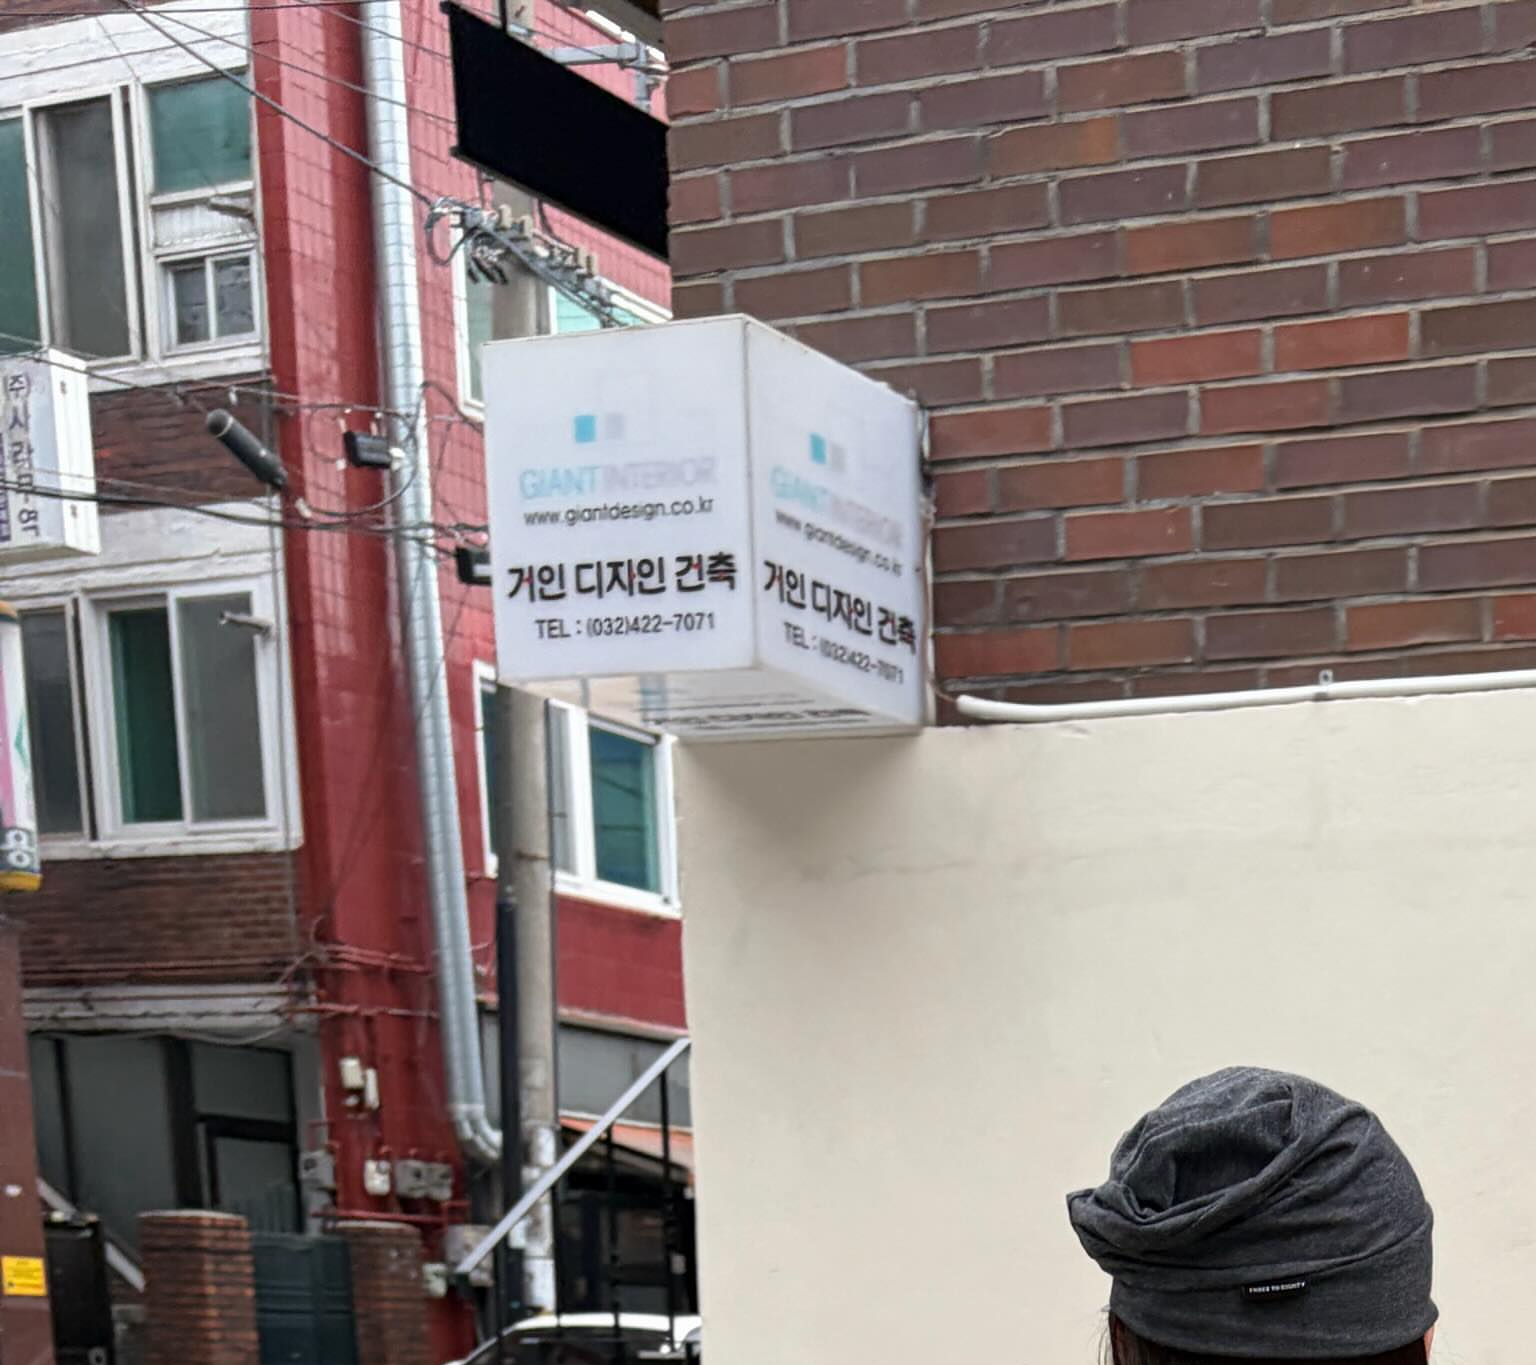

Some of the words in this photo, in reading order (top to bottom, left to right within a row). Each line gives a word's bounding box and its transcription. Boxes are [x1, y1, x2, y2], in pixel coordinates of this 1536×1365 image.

[523, 495, 714, 527] www.giantdesign.co.kr
[507, 563, 567, 603] 거인
[575, 556, 667, 599] 디자인
[675, 551, 738, 593] 건축
[586, 612, 716, 639] (032)422-7071
[763, 559, 807, 610] 거인
[811, 580, 873, 636] 디자인
[877, 606, 917, 655] 건축
